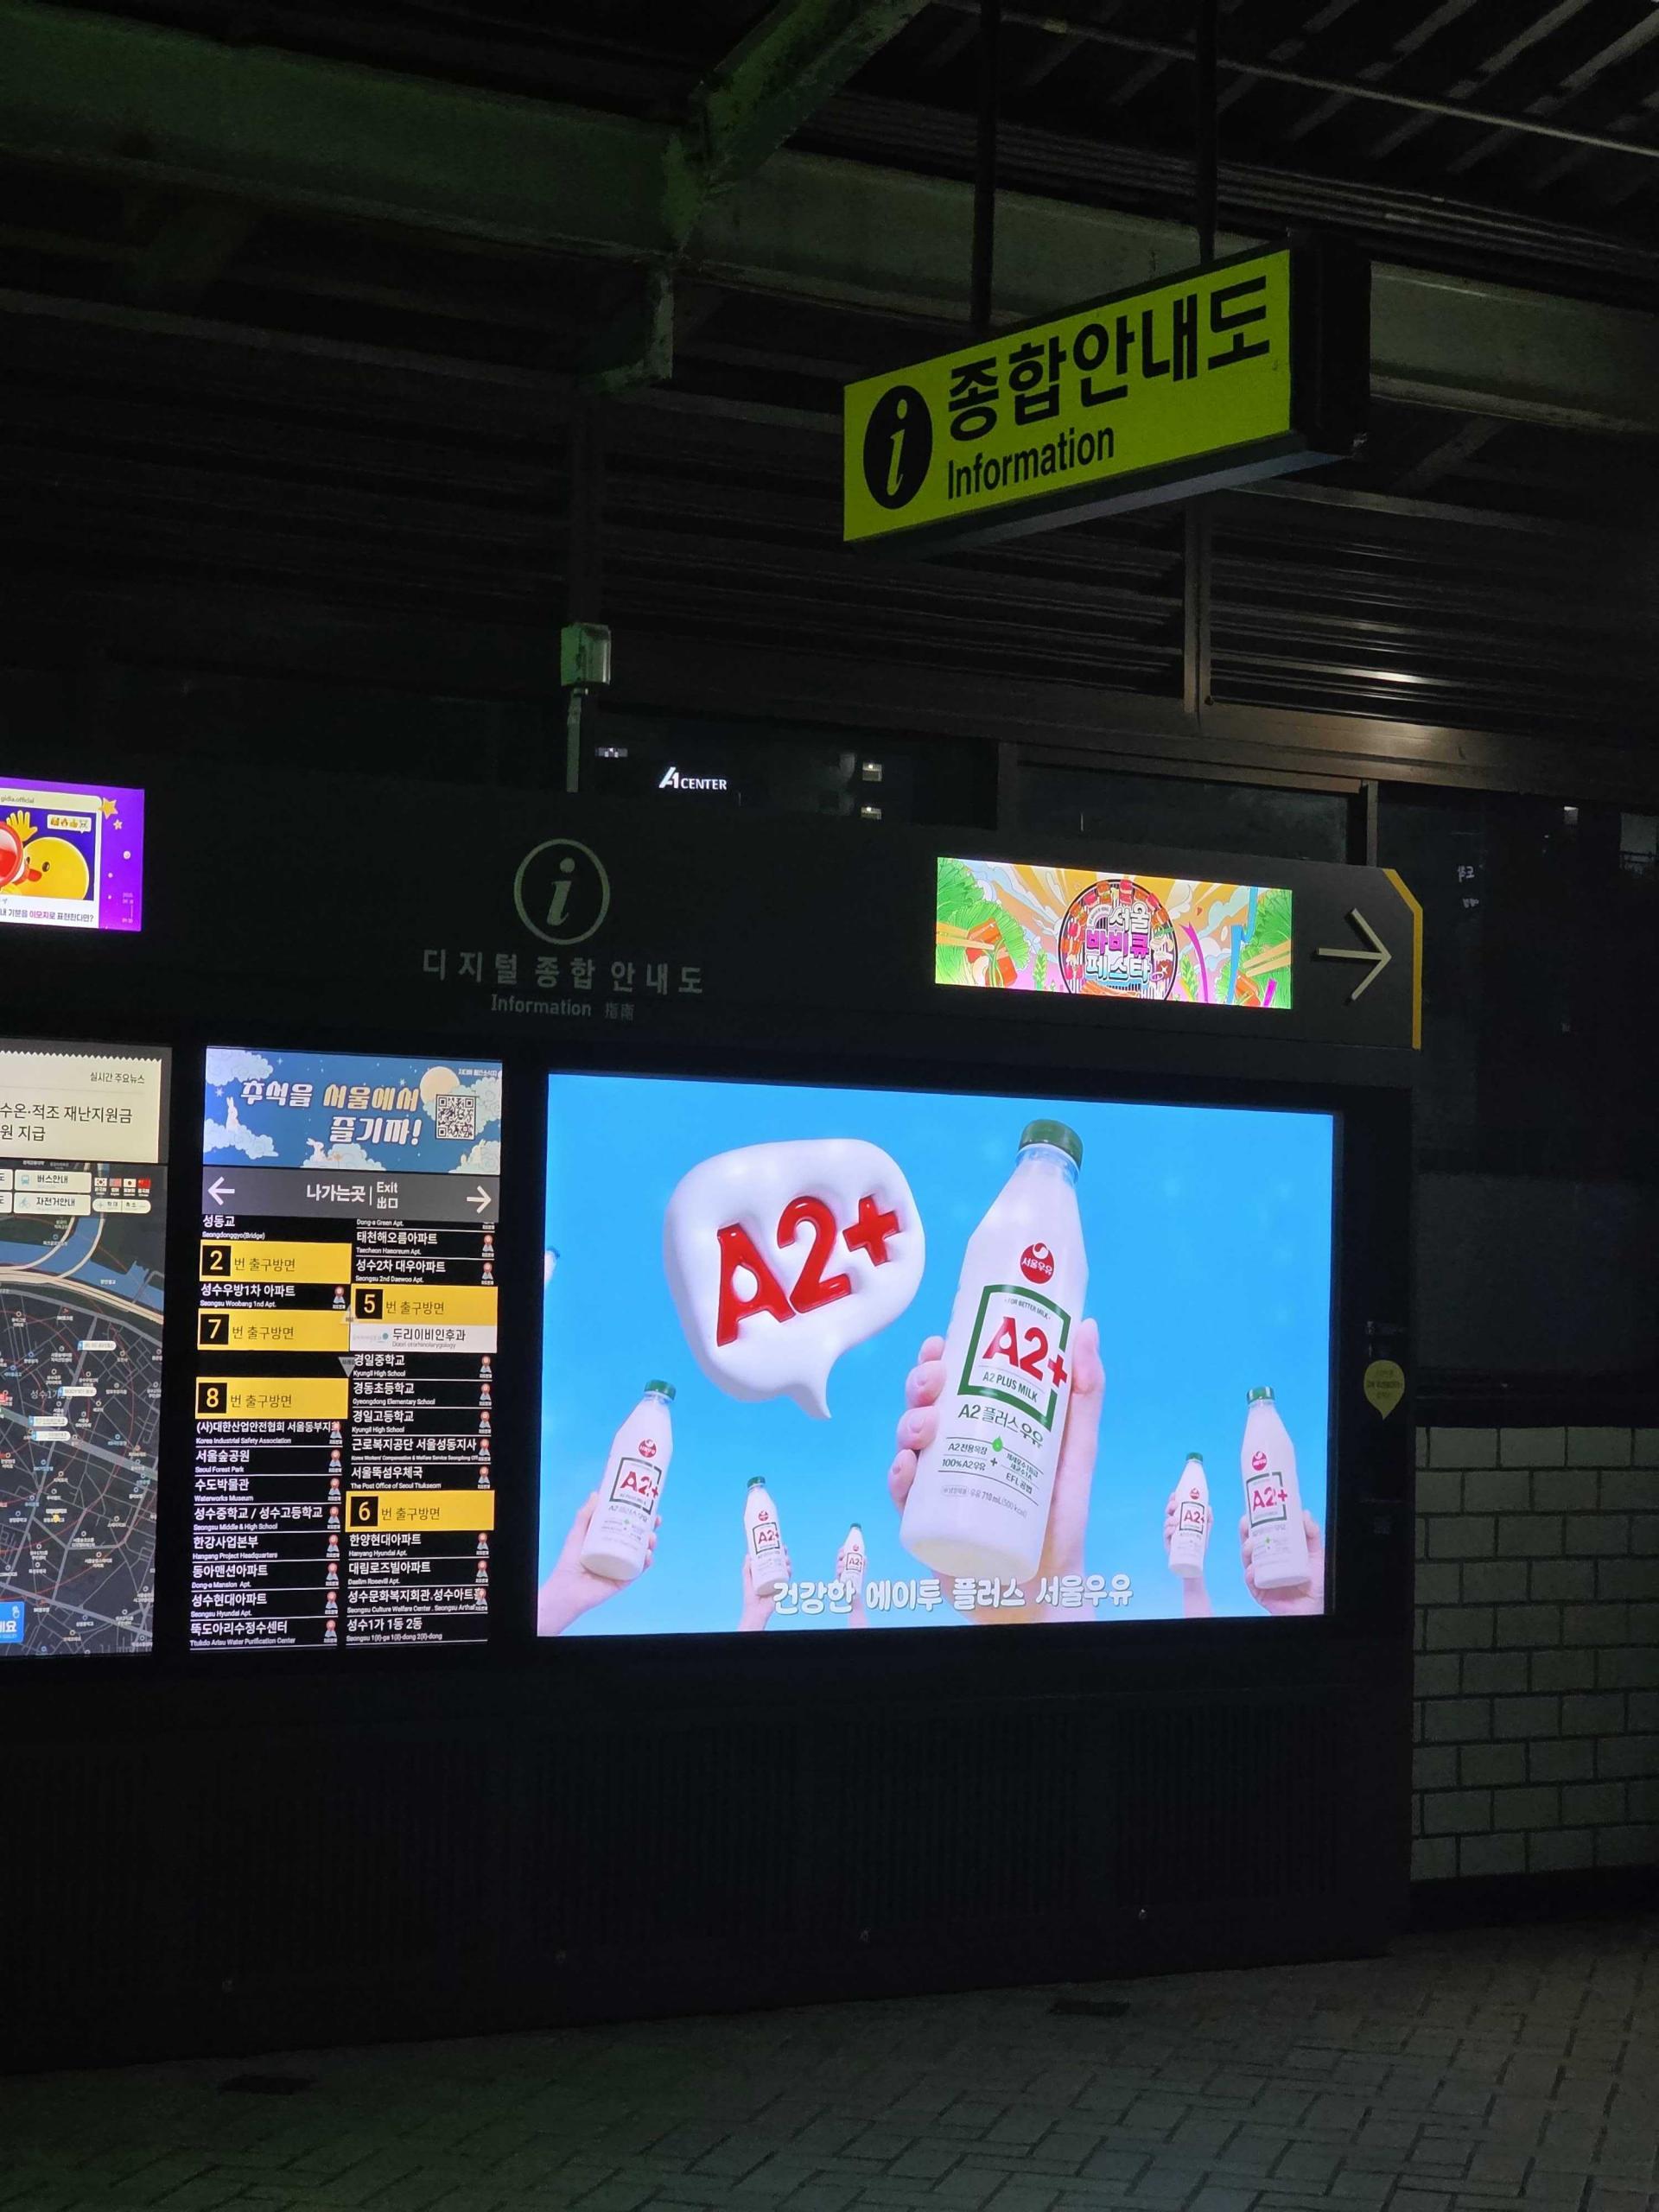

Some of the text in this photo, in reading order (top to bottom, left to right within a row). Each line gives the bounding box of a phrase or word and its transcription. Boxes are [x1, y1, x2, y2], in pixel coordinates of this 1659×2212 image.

[947, 275, 1270, 442] 종합안내도
[948, 426, 1114, 499] Information
[681, 778, 727, 791] CENTER
[10, 909, 28, 918] 기분을
[29, 911, 55, 920] 이모지로
[1109, 902, 1149, 933] 서울
[1086, 930, 1149, 960] 바비큐
[423, 950, 703, 995] 디지털 종합 안내도
[1086, 955, 1151, 983] 페스타
[491, 995, 635, 1021] Information 指南
[90, 1072, 145, 1084] 실시간 주요뉴스
[240, 1080, 421, 1113] 추석을 서울에서
[64, 1105, 133, 1124] 재난지원금
[18, 1125, 46, 1141] 지급
[37, 1175, 68, 1184] 버스안내
[307, 1184, 365, 1202] 나가는곳
[377, 1182, 397, 1193] Exit
[36, 1197, 75, 1207] 자전거안내
[377, 1196, 397, 1210] 出口
[203, 1215, 235, 1228] 성동교
[356, 1231, 438, 1245] 태천해오름아파트
[210, 1250, 223, 1270] 2
[234, 1258, 296, 1273] 번 출구방면
[356, 1260, 446, 1274] 성수2차 대우아파트
[1021, 1257, 1053, 1276] 서울우유
[716, 1194, 901, 1347] A2+
[200, 1283, 296, 1298] 성수우방1차 아파트
[364, 1294, 376, 1313] 5
[386, 1301, 444, 1315] 번 출구방면
[208, 1319, 221, 1339] 7
[232, 1326, 295, 1340] 번 출구방면
[392, 1328, 466, 1341] 두리이비인후과
[982, 1316, 1067, 1389] A2+
[354, 1354, 405, 1367] 경일중학교
[353, 1382, 415, 1395] 경동초등학교
[982, 1371, 1038, 1403] A2 PLUS MILK
[206, 1387, 219, 1408] 8
[231, 1394, 292, 1408] 번 출구방면
[353, 1410, 415, 1423] 경일고등학교
[957, 1404, 982, 1420] A2
[196, 1421, 285, 1434] (사)대한산업안전협회
[352, 1439, 414, 1452] 근로복지공단
[416, 1438, 477, 1452] 서울성동지사
[196, 1450, 250, 1463] 서울숲공원
[942, 1459, 987, 1471] 100%A2우유
[351, 1466, 423, 1479] 서울뚝섬우체국
[194, 1478, 250, 1491] 수도박물관
[194, 1508, 249, 1521] 성수중학교
[259, 1506, 323, 1519] 성수고등학교
[359, 1501, 371, 1521] 6
[381, 1507, 441, 1521] 번 출구방면
[193, 1536, 258, 1549] 한강사업본부
[349, 1534, 422, 1547] 한양현대아파트
[192, 1565, 268, 1579] 동아맨션아파트
[348, 1561, 431, 1575] 대림로즈빌아파트
[192, 1593, 267, 1607] 성수현대아파트
[772, 1573, 1134, 1615] 건강한 에이투 플러스 서울우유
[191, 1620, 288, 1636] 뚝도아리수정수센터
[347, 1618, 423, 1632] 성수1가 1동 2동
